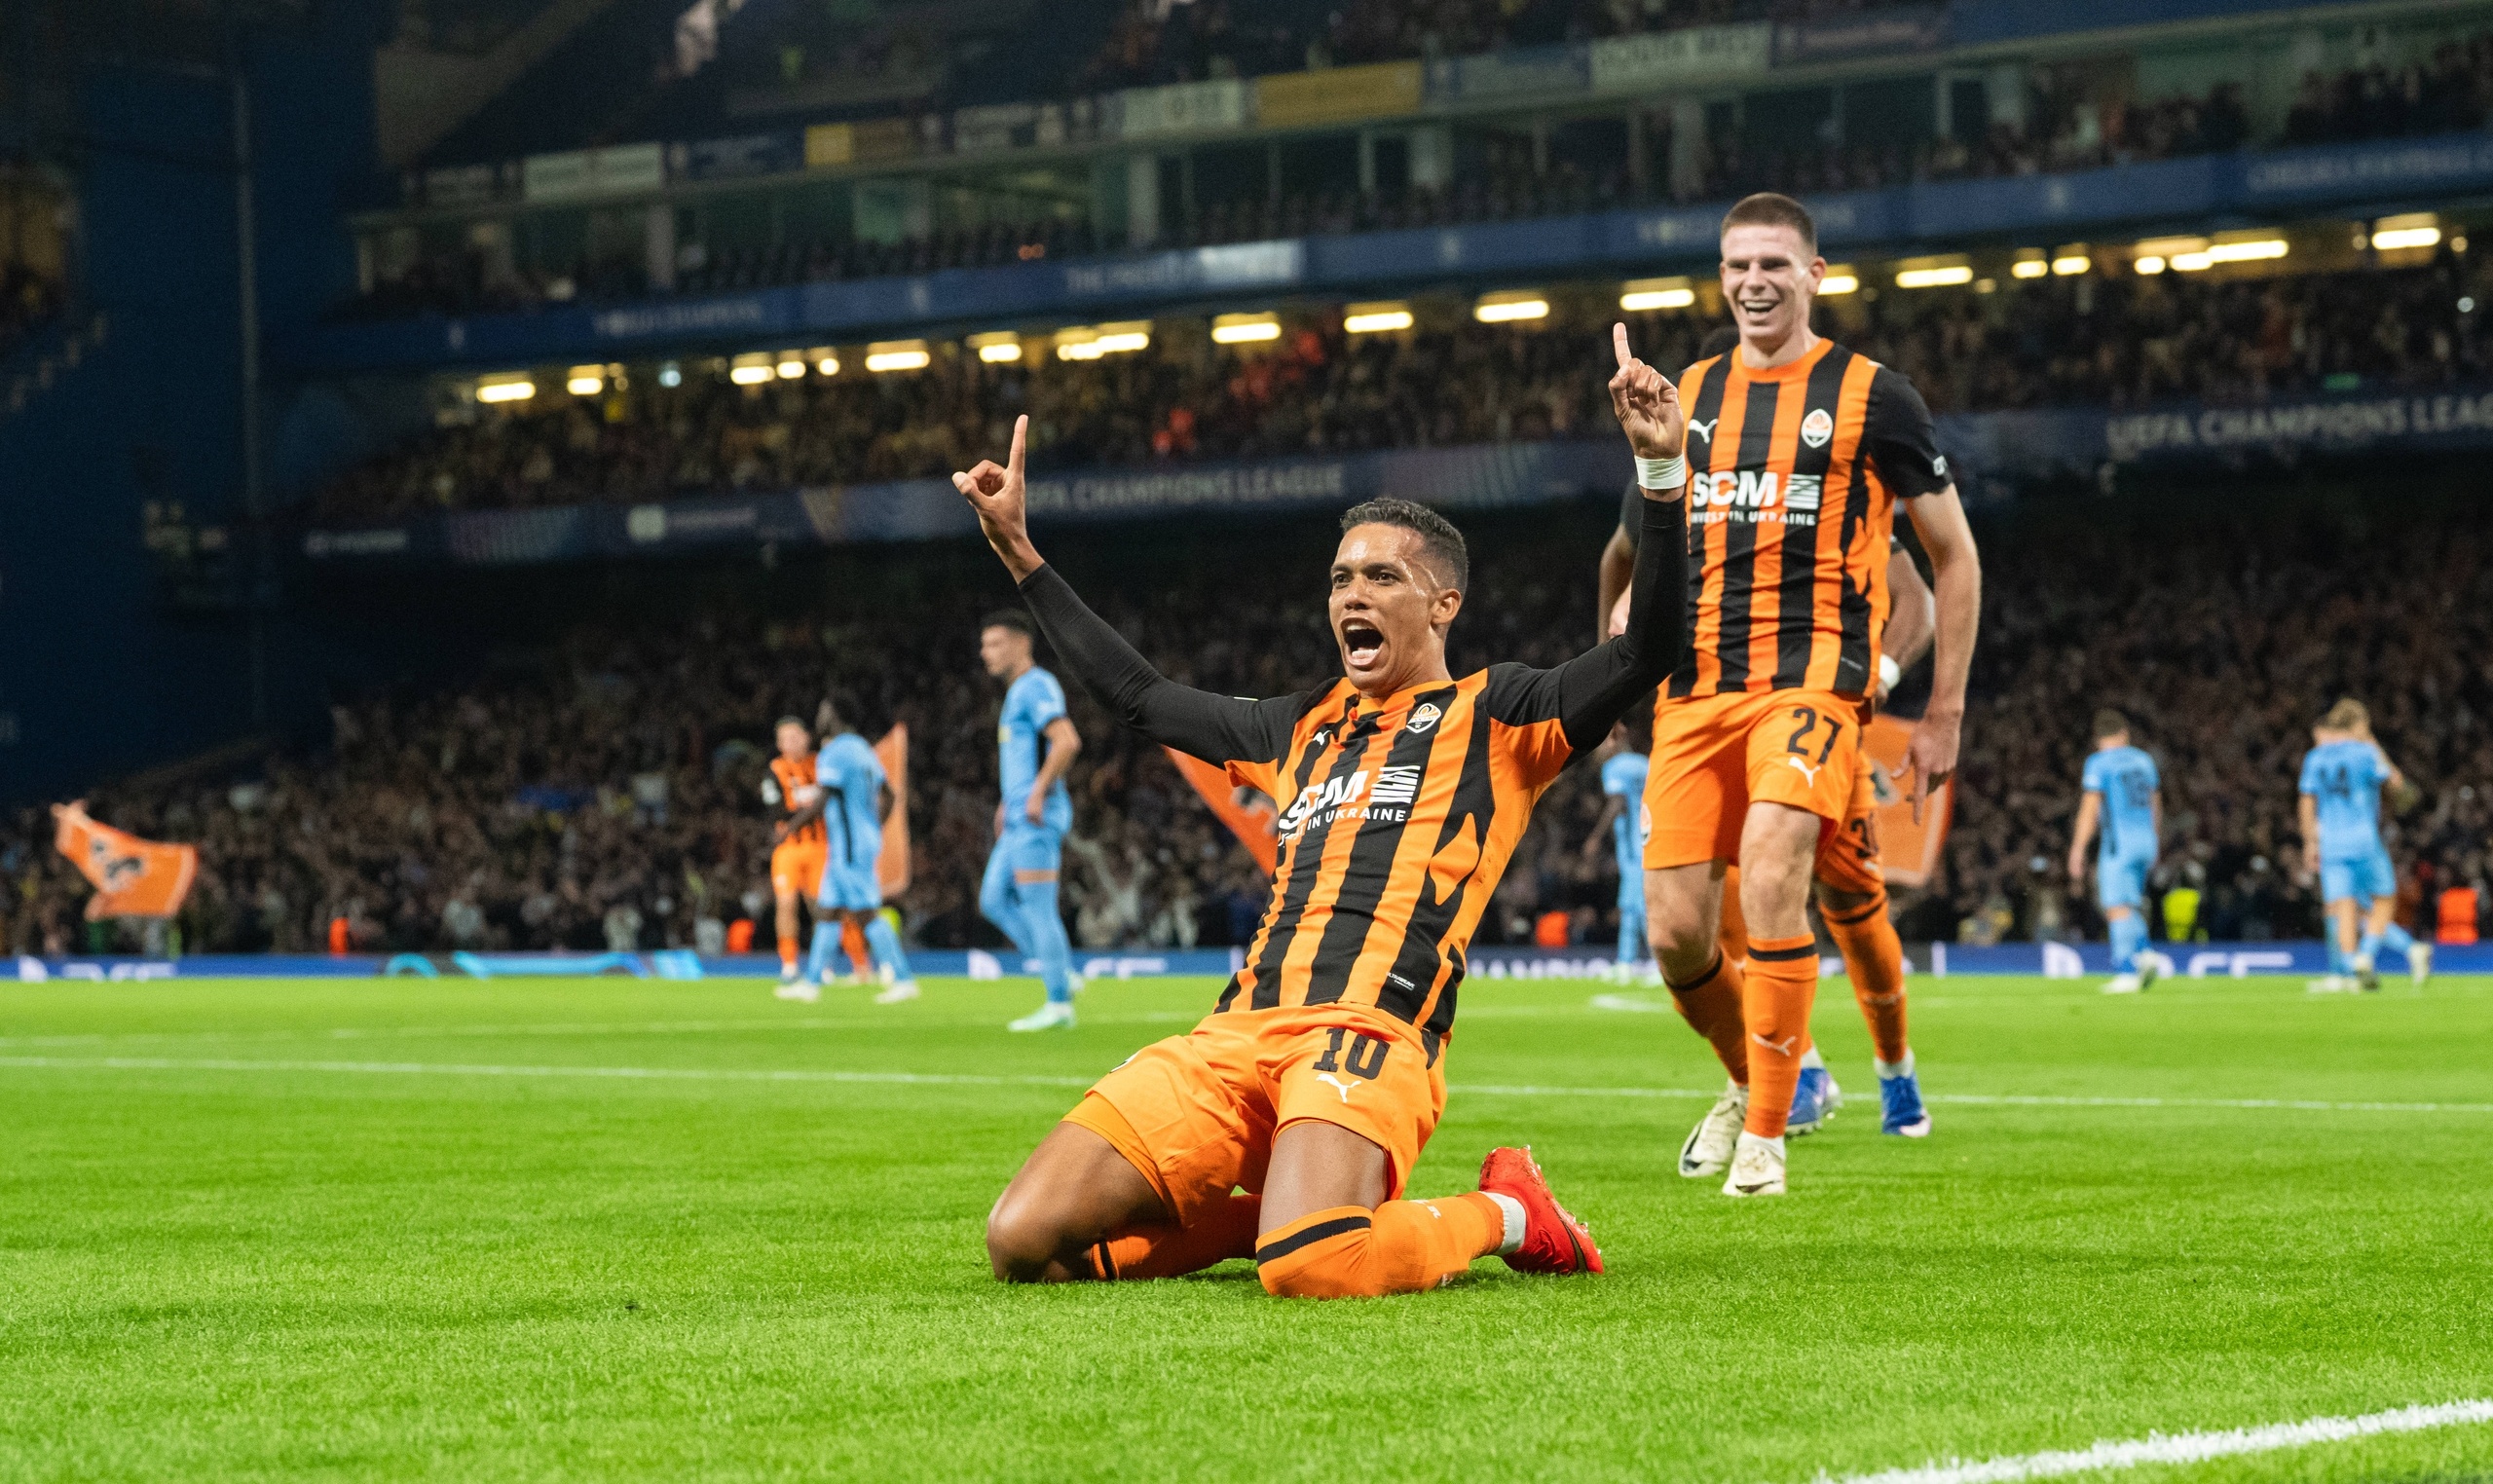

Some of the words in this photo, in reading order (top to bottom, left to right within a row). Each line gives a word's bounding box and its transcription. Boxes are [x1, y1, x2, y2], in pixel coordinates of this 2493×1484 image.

[2198, 399, 2405, 446] CHAMPIONS
[1073, 471, 1232, 504] CHAMPIONS
[1238, 463, 1343, 500] LEAGUE
[1693, 470, 1778, 506] SCM
[1729, 510, 1744, 522] IN
[1748, 511, 1816, 526] UKRAINE
[1787, 708, 1842, 764] 27
[1279, 770, 1369, 829] SCM
[1307, 814, 1321, 831] IN
[1325, 806, 1407, 824] UKRAINE
[1312, 1027, 1391, 1080] 10
